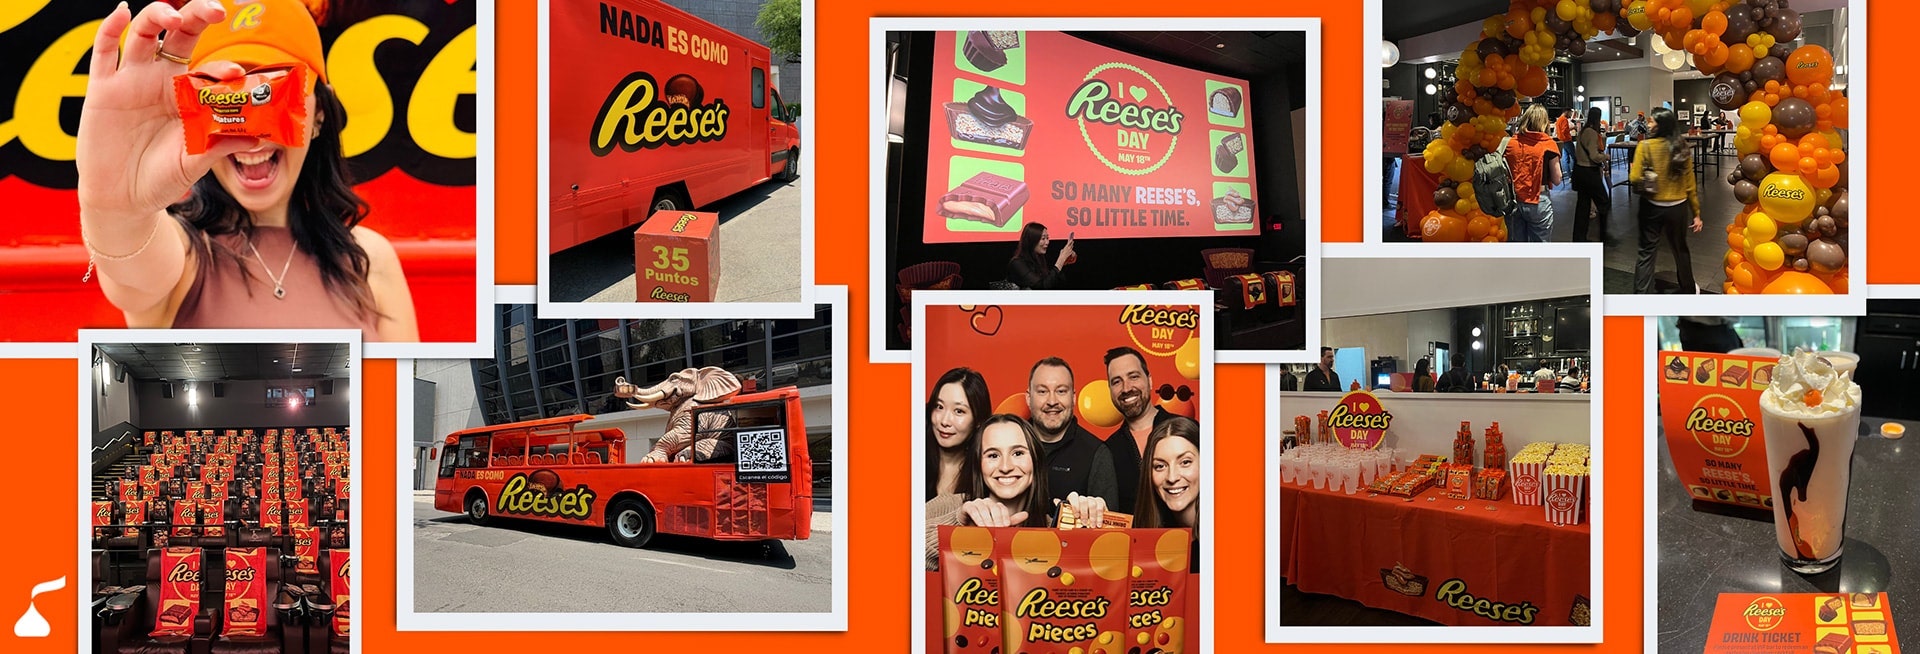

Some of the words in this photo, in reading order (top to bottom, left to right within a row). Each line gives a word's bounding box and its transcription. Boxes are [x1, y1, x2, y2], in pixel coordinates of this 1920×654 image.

[600, 3, 664, 49] NADA
[667, 26, 689, 55] ES
[691, 34, 729, 66] COMO
[199, 87, 249, 105] Reese's
[596, 77, 728, 150] Reese's
[1066, 81, 1183, 134] Reese's
[1117, 129, 1150, 150] DAY
[1118, 153, 1135, 163] MAY
[1051, 180, 1078, 201] SO
[1081, 183, 1132, 203] MANY
[1135, 186, 1201, 207] REESE'S,
[1763, 184, 1805, 201] Reese's
[1066, 207, 1092, 227] SO
[1095, 208, 1147, 227] LITTLE
[1150, 209, 1190, 227] TIME.
[652, 245, 690, 272] 35
[645, 268, 699, 286] Puntos
[651, 286, 691, 302] Reese's
[1120, 305, 1199, 329] Reese's
[1152, 327, 1174, 340] DAY
[1353, 402, 1356, 412] I
[1711, 406, 1716, 417] I
[1327, 404, 1392, 429] Reese's
[1687, 408, 1754, 436] Reese's
[1351, 430, 1368, 440] DAY
[1712, 435, 1731, 445] DAY
[1705, 459, 1717, 467] SO
[1718, 462, 1742, 470] MANY
[460, 470, 475, 479] NADA
[476, 470, 484, 480] ES
[485, 470, 504, 480] COMO
[1711, 479, 1736, 488] LITTLE
[498, 475, 593, 517] Reese's
[1017, 588, 1110, 617] Reese's
[1437, 579, 1537, 624] Reese's
[1743, 603, 1786, 616] Reese's
[1028, 623, 1097, 642] pieces
[1722, 632, 1759, 643] DRINK
[1762, 632, 1801, 643] TICKET
